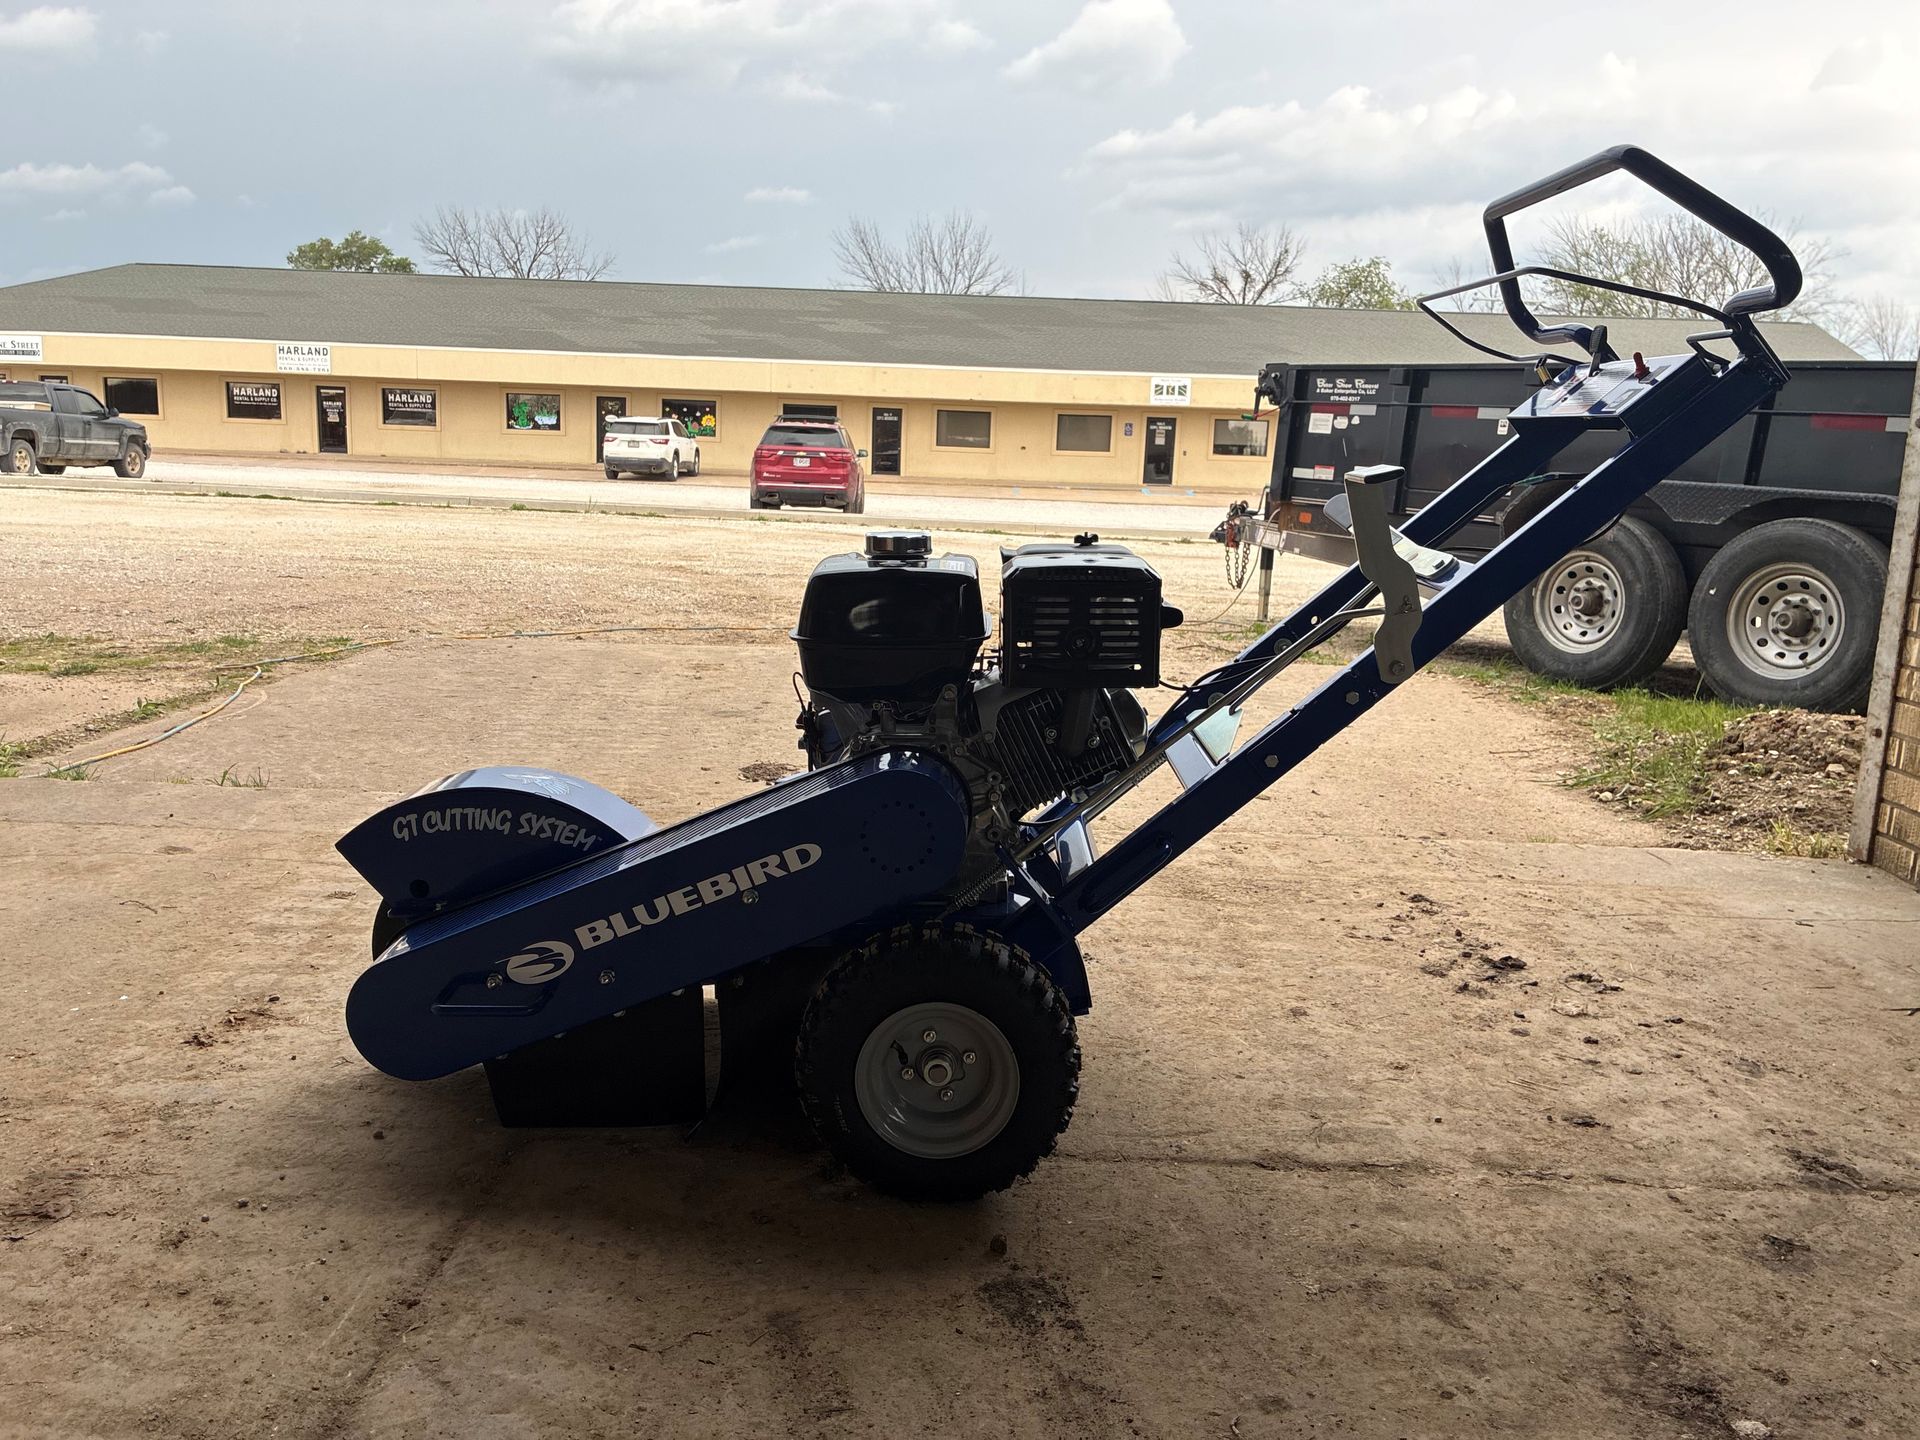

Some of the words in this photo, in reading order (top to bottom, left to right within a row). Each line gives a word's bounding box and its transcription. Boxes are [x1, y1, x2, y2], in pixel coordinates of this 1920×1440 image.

[11, 339, 39, 349] STREET
[278, 345, 329, 356] HARLAND
[1354, 378, 1380, 390] Removal
[233, 387, 278, 397] HARLAND
[388, 393, 433, 403] HARLAND
[392, 813, 418, 842] GT
[422, 807, 513, 836] CUTTING
[518, 811, 597, 851] SYSTEM
[574, 843, 823, 951] BLUEBIRD
